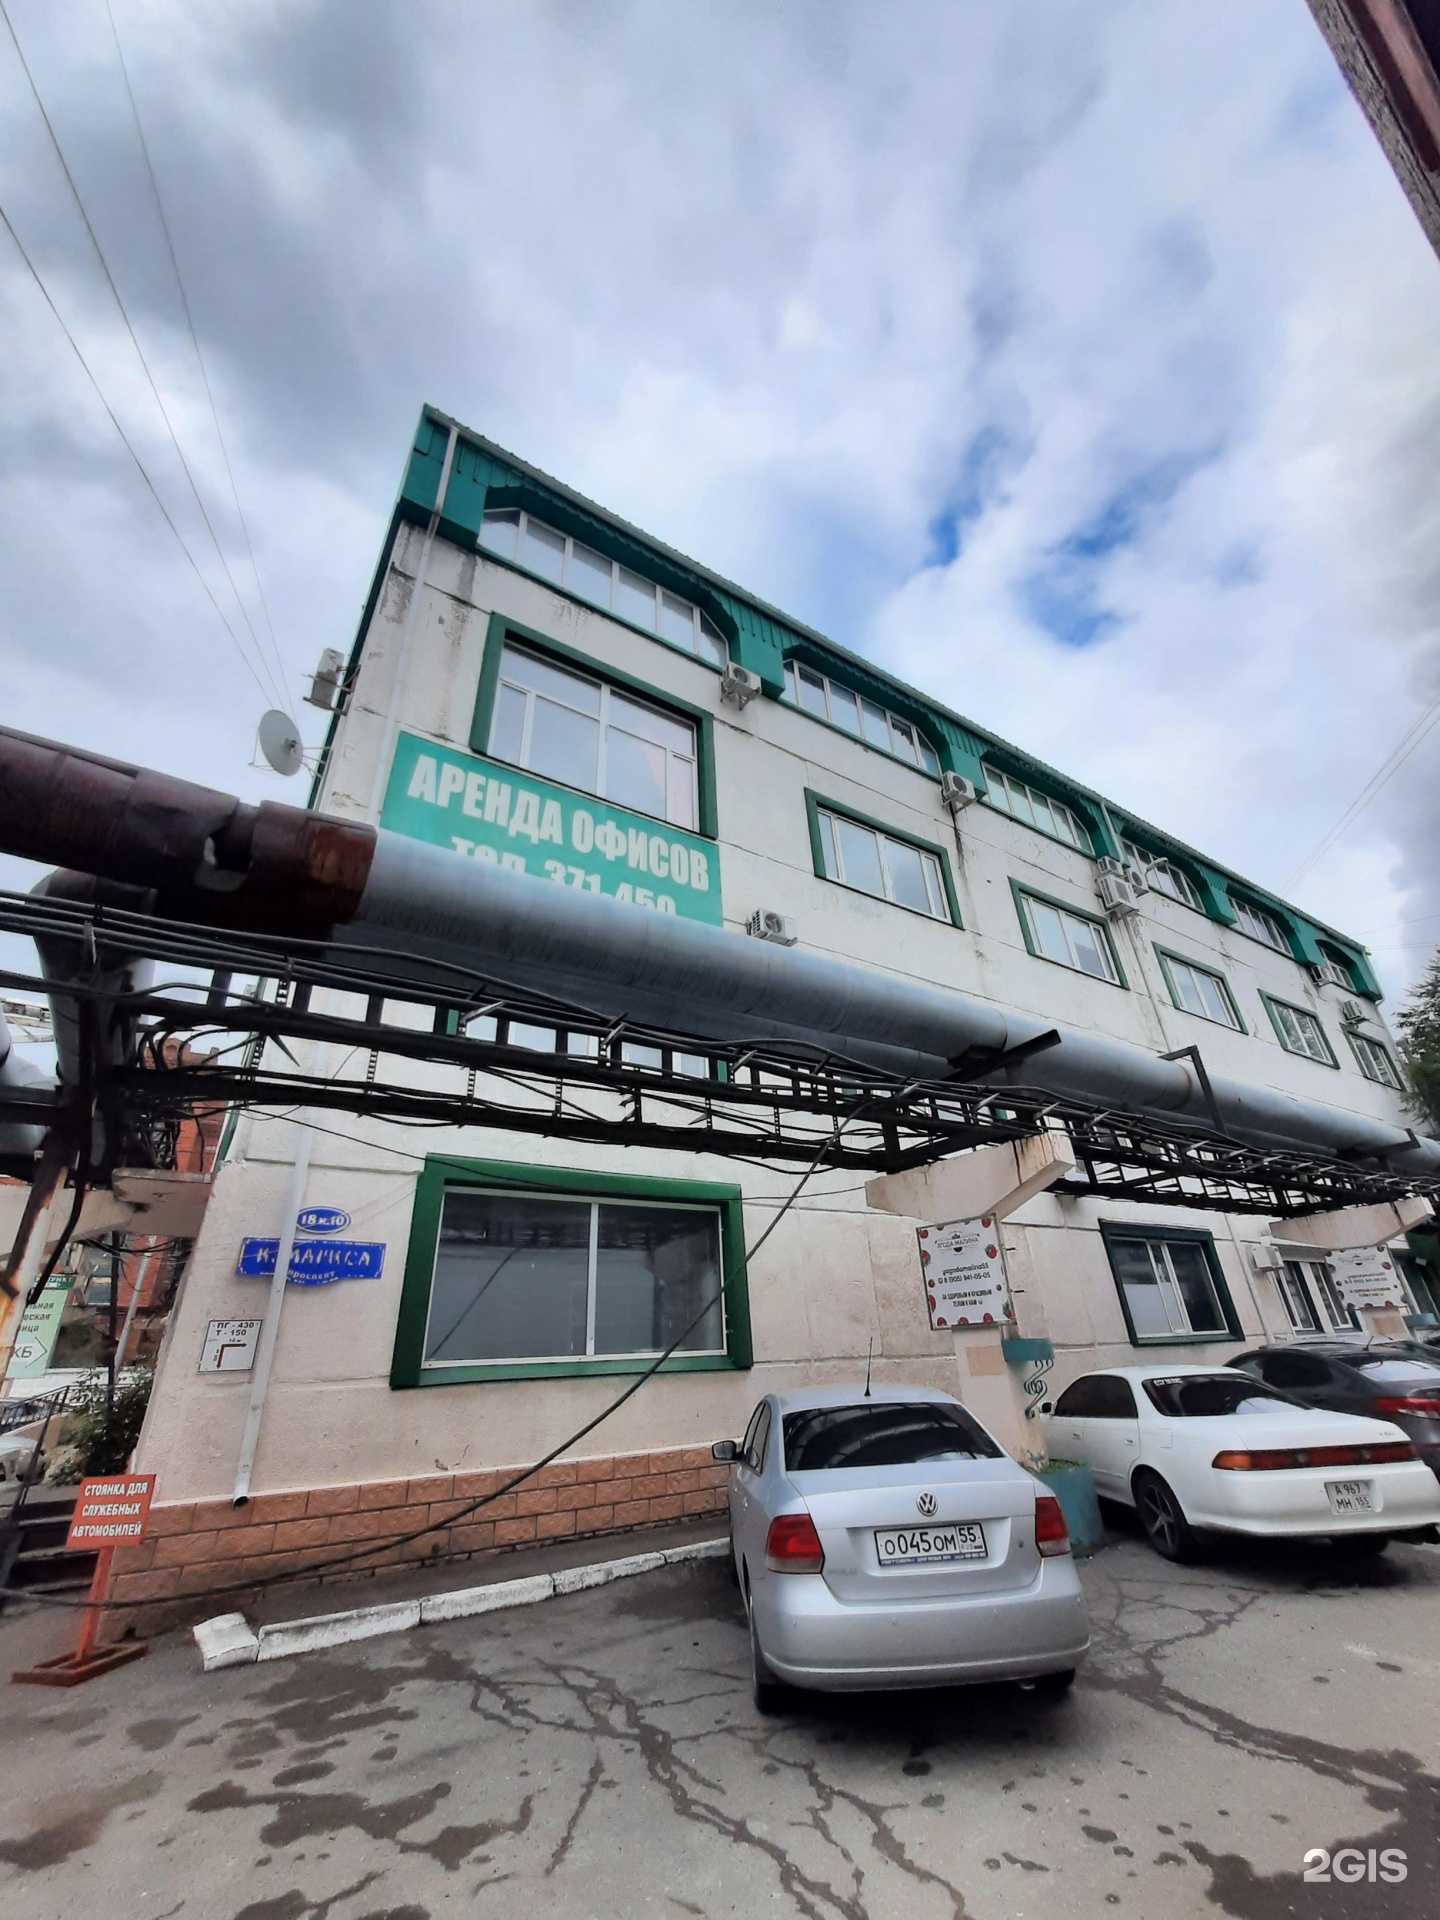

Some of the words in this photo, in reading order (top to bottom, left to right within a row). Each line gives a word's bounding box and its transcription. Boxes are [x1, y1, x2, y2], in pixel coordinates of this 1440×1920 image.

[407, 754, 564, 845] АРЕНДА
[571, 809, 710, 893] ОФИСОВ
[301, 1213, 317, 1226] 18
[84, 1483, 126, 1497] СТОЯНКА
[127, 1482, 148, 1496] ДЛЯ
[82, 1503, 141, 1517] СЛУЖЕБНЫХ
[72, 1521, 142, 1537] АВТОМОБИЛЕЙ
